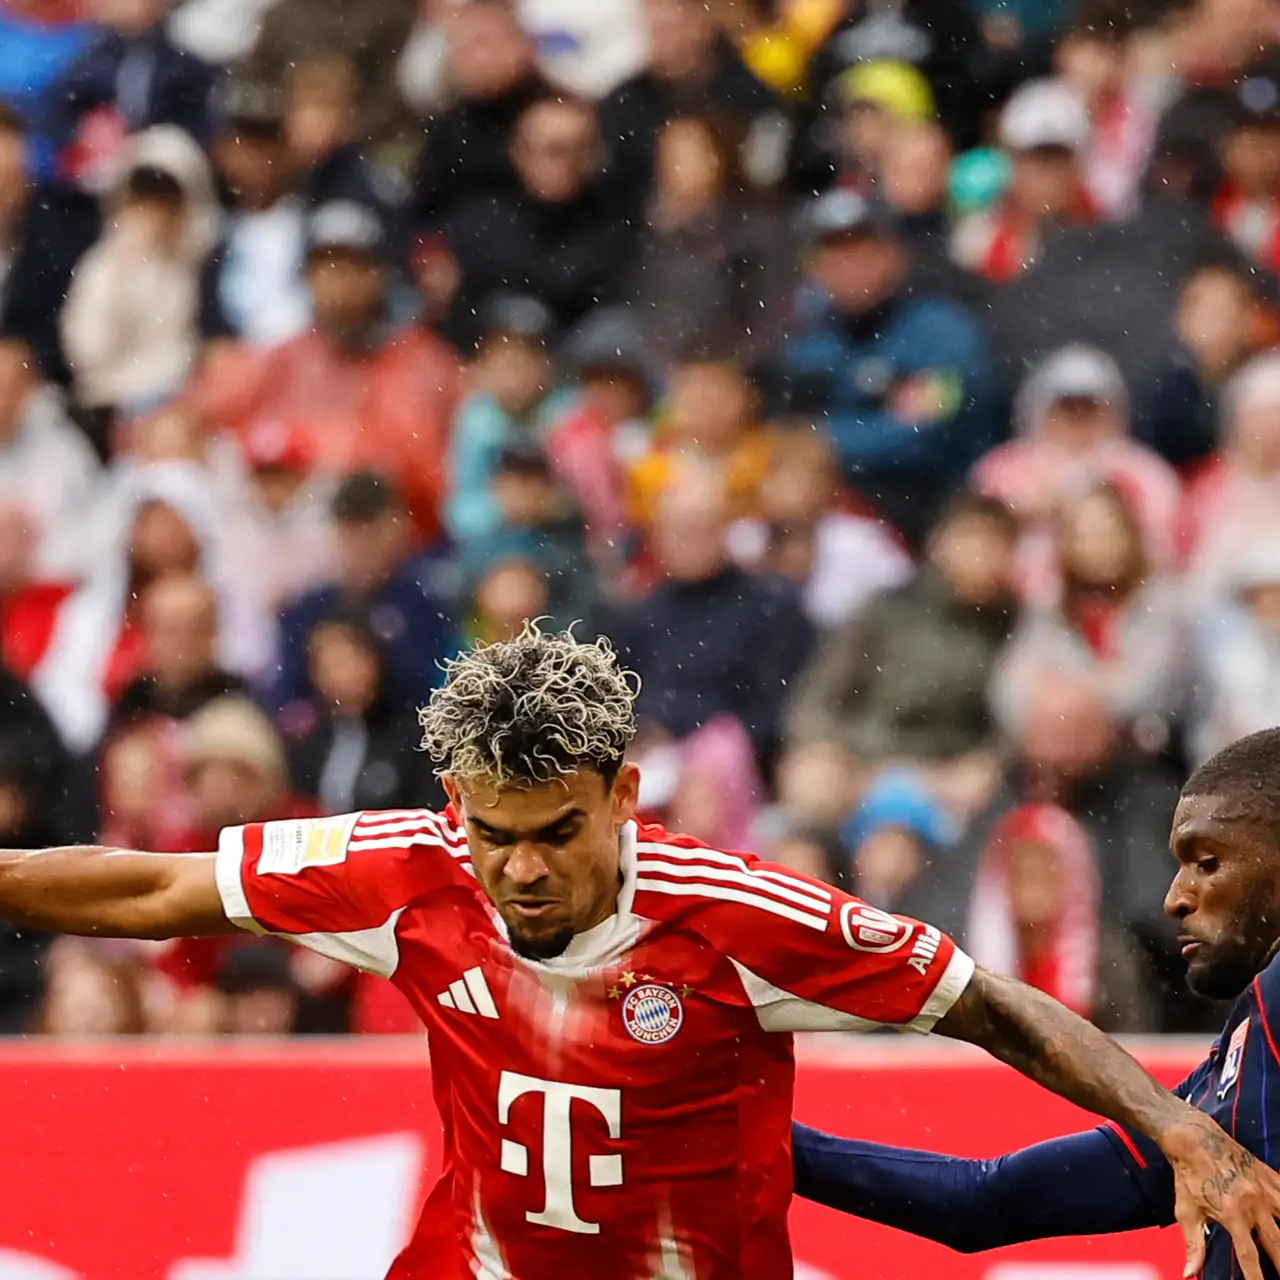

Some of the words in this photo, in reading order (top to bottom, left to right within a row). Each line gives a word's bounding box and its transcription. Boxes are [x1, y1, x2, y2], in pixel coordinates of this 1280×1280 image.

[627, 996, 639, 1011] FC
[637, 988, 677, 1009] BAYERN
[497, 1070, 623, 1235] T
